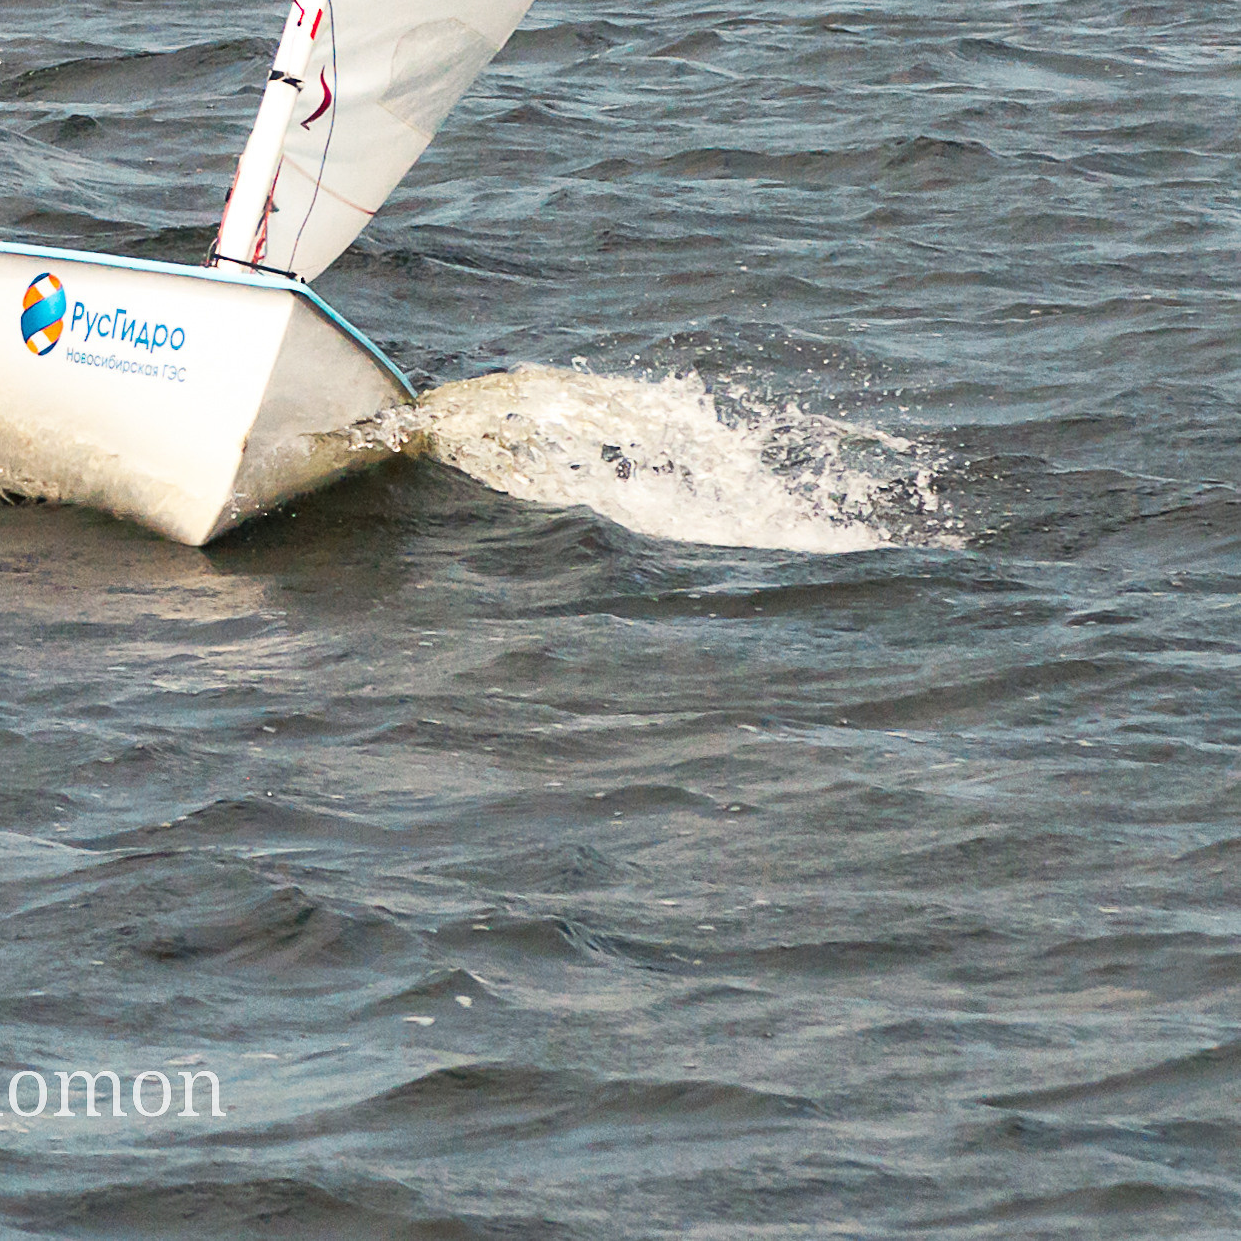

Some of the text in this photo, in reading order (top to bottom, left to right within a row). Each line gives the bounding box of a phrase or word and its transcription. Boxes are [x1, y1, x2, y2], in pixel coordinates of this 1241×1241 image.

[70, 301, 185, 354] РусГидро
[66, 347, 187, 383] Новосибирская ГЭС
